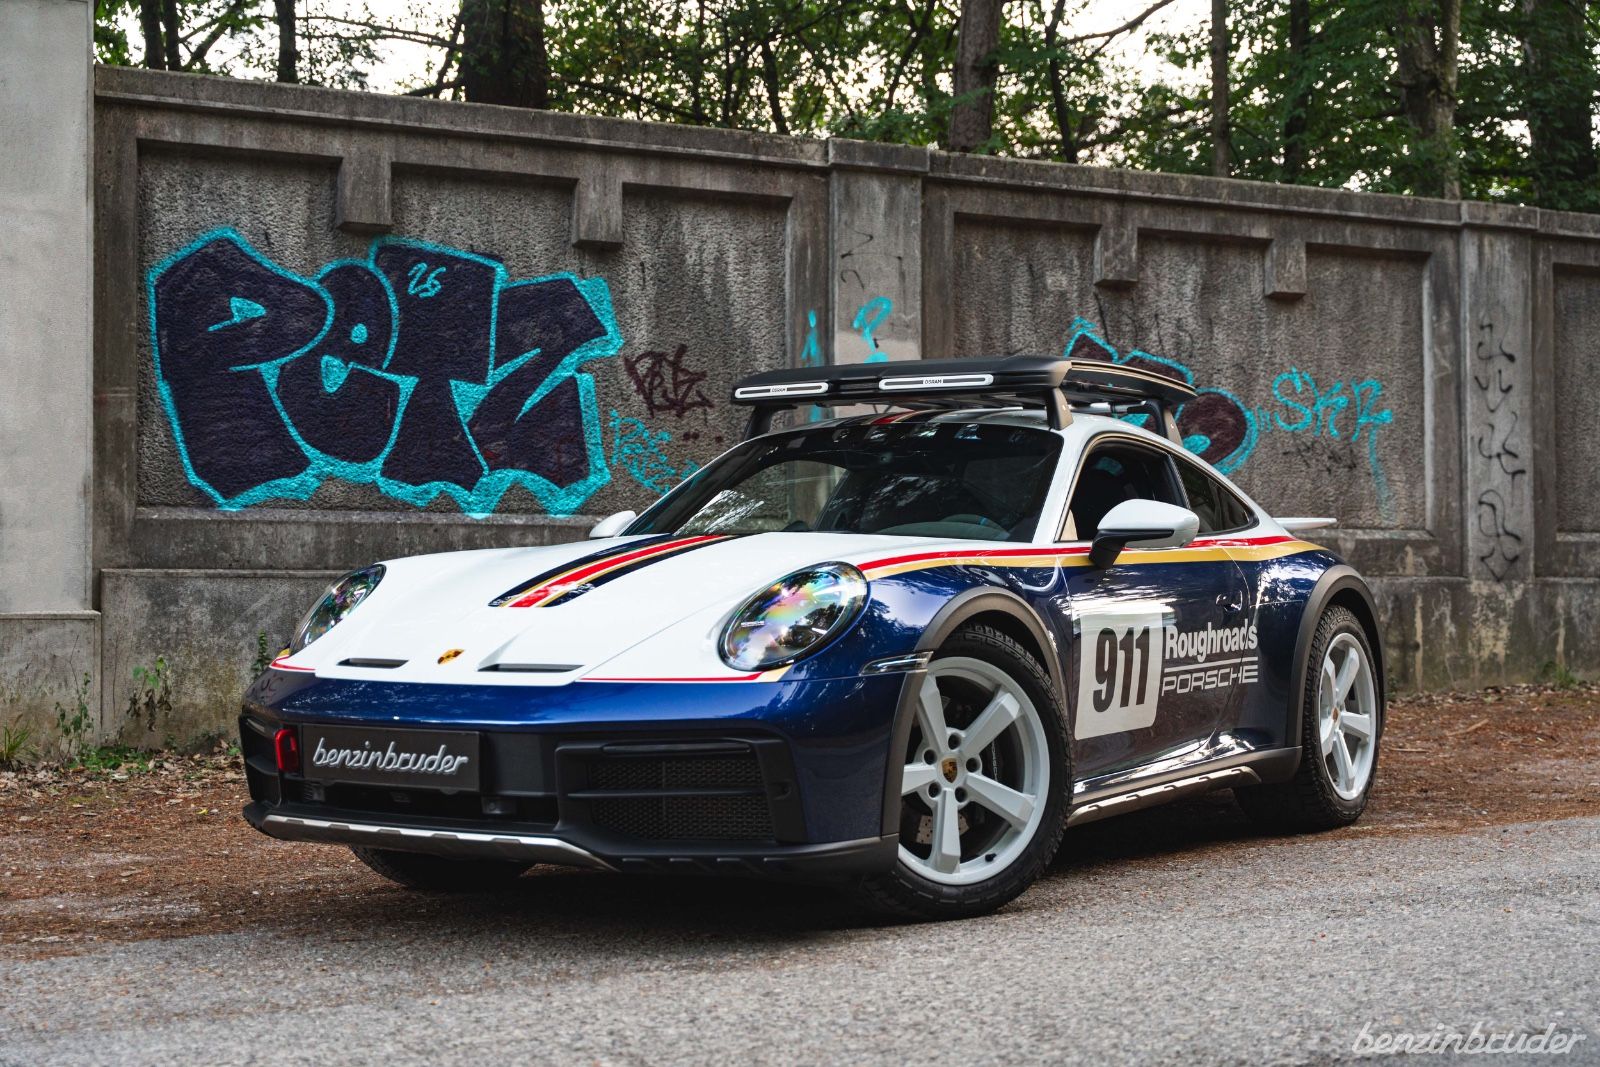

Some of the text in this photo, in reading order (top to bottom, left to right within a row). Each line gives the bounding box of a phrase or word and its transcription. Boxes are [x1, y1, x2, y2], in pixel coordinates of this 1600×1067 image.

[1164, 618, 1259, 663] Roughroads
[1092, 625, 1151, 713] 911
[1161, 664, 1259, 697] PORSCHE
[313, 736, 470, 775] benzinbruder
